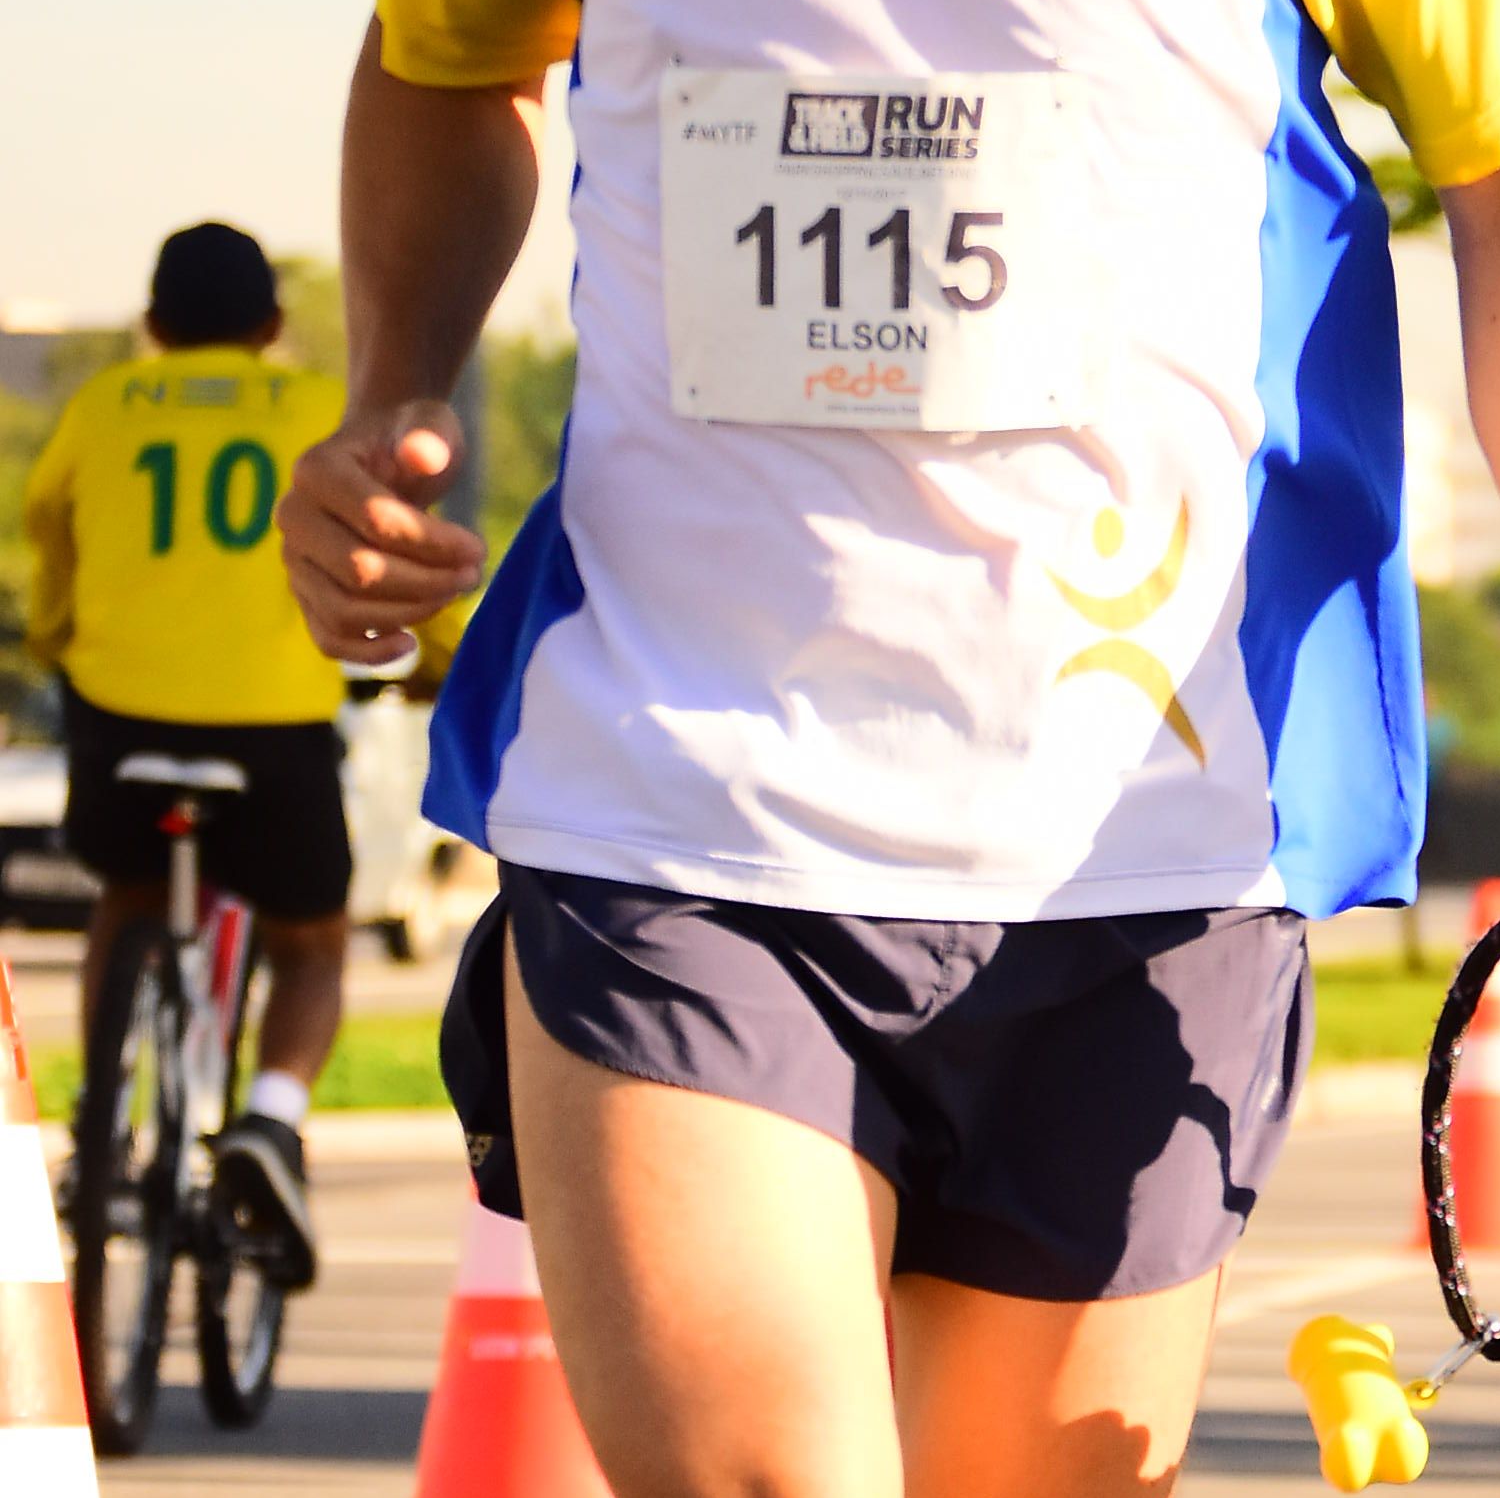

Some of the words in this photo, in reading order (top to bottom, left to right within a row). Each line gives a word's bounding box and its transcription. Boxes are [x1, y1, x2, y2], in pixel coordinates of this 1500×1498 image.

[883, 95, 985, 132] RUN
[880, 135, 979, 159] SERIES
[736, 205, 1008, 312] 1115
[807, 322, 928, 351] ELSON
[804, 360, 923, 400] rede
[135, 441, 278, 556] 10
